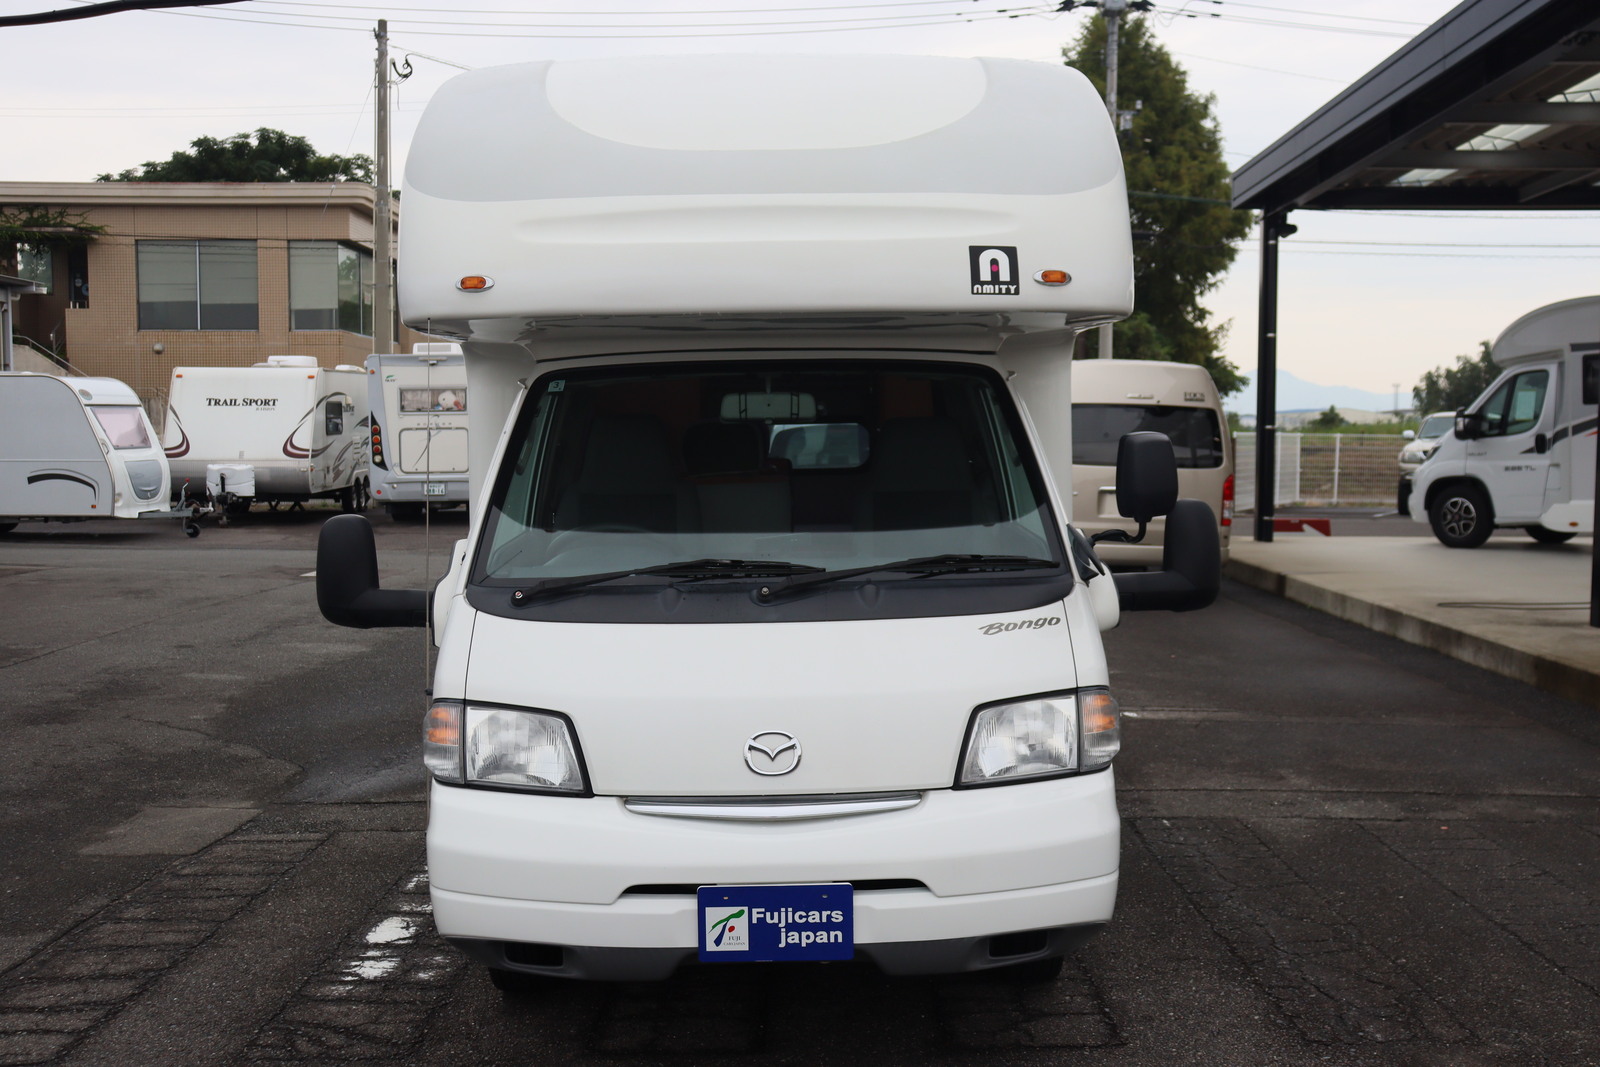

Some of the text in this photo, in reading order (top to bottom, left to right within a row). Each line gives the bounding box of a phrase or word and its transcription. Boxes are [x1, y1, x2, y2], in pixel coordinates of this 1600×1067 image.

[973, 284, 1017, 294] AMITY
[206, 397, 279, 407] TRAIL SPORT
[978, 616, 1061, 636] Bongo
[751, 907, 844, 928] Fujicars
[778, 928, 843, 948] japan
